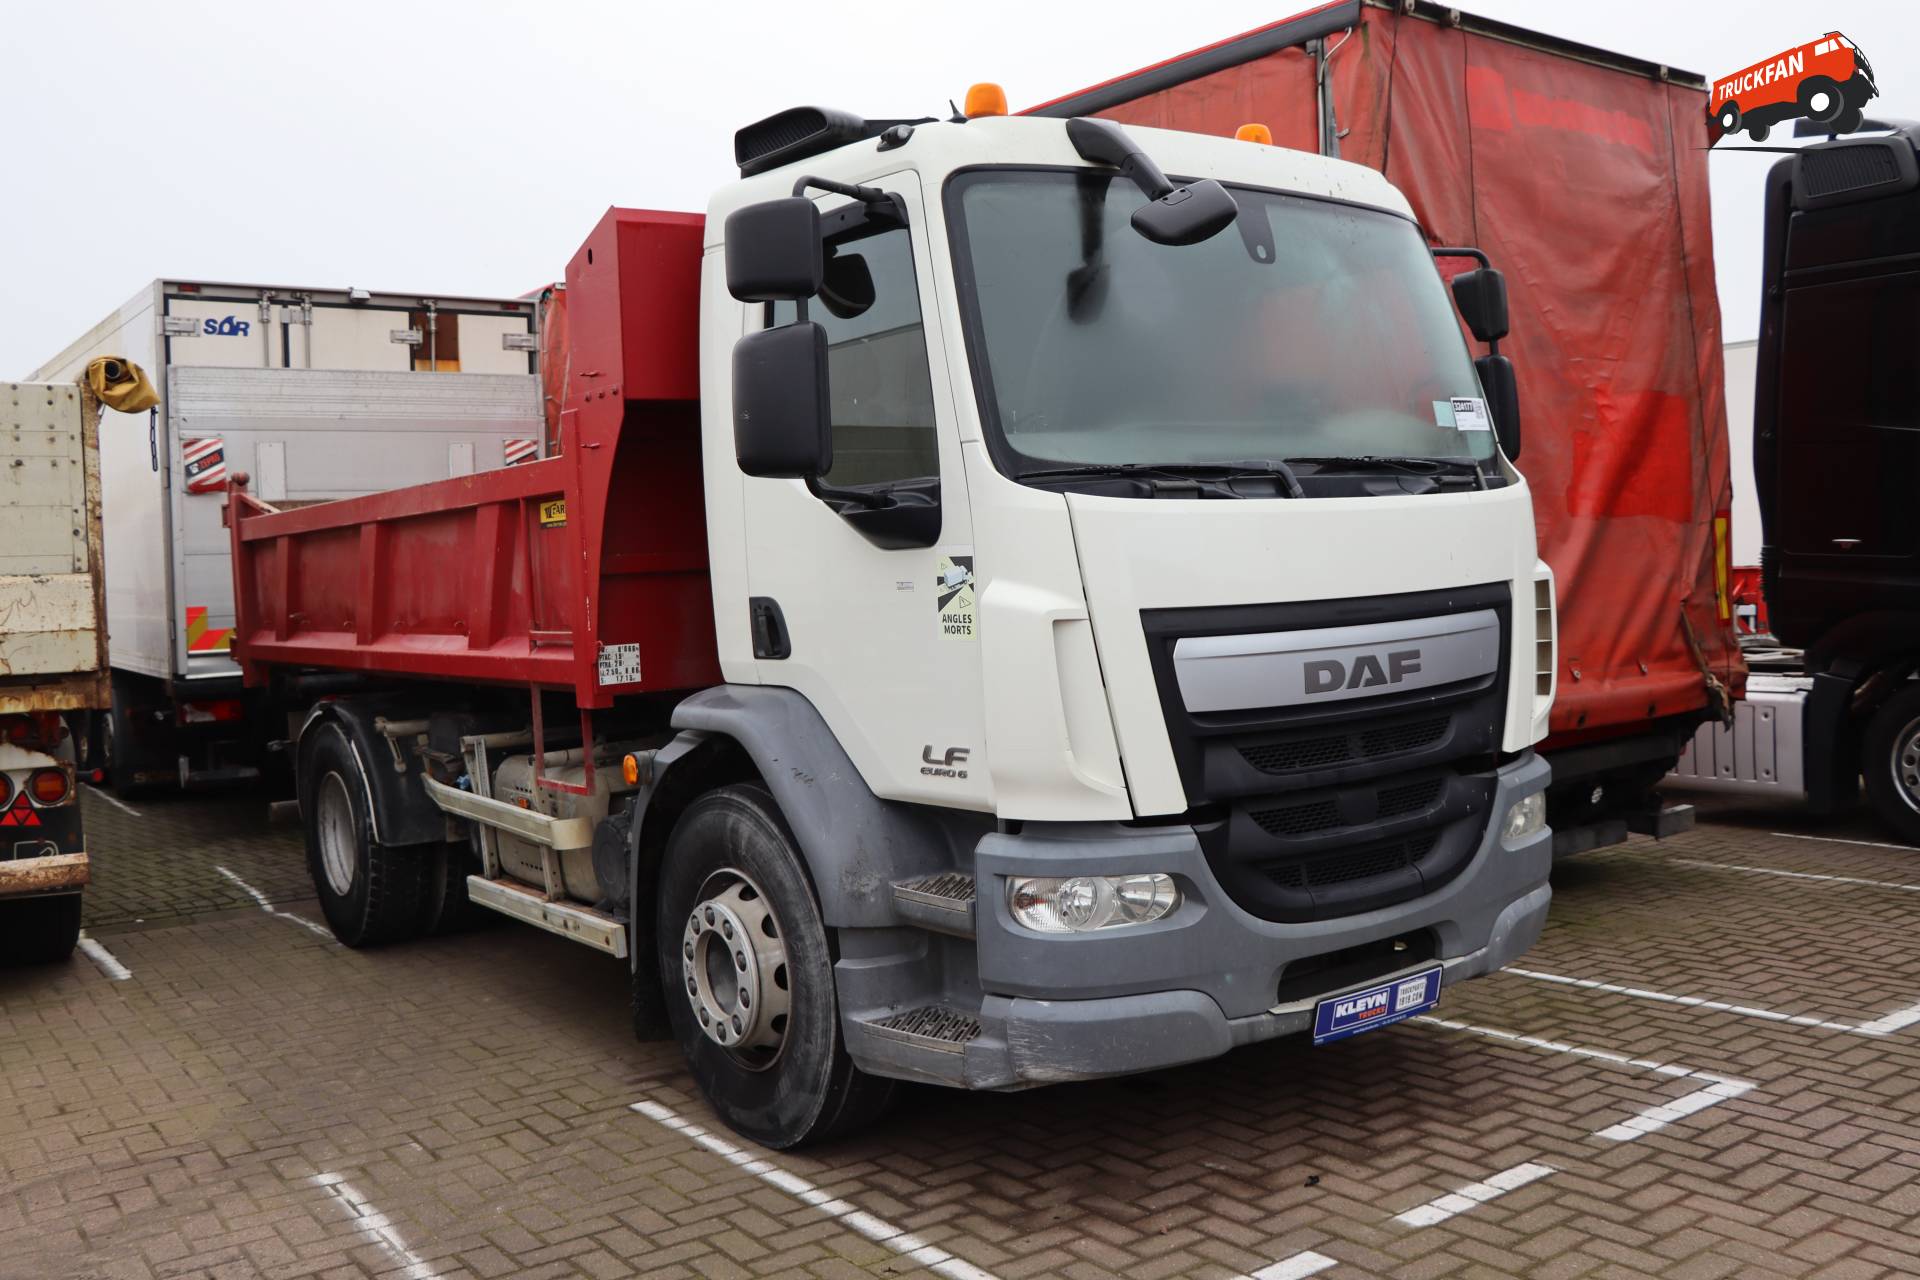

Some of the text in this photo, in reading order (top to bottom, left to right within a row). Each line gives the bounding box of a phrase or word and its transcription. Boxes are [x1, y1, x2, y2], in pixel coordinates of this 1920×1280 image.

[942, 613, 972, 624] ANGLES
[944, 624, 972, 635] MORTS
[1304, 649, 1421, 694] DAF
[922, 744, 970, 766] LF
[920, 767, 968, 779] EURO 6
[1336, 992, 1387, 1017] KLEYN
[1359, 1005, 1387, 1019] TRUCKS
